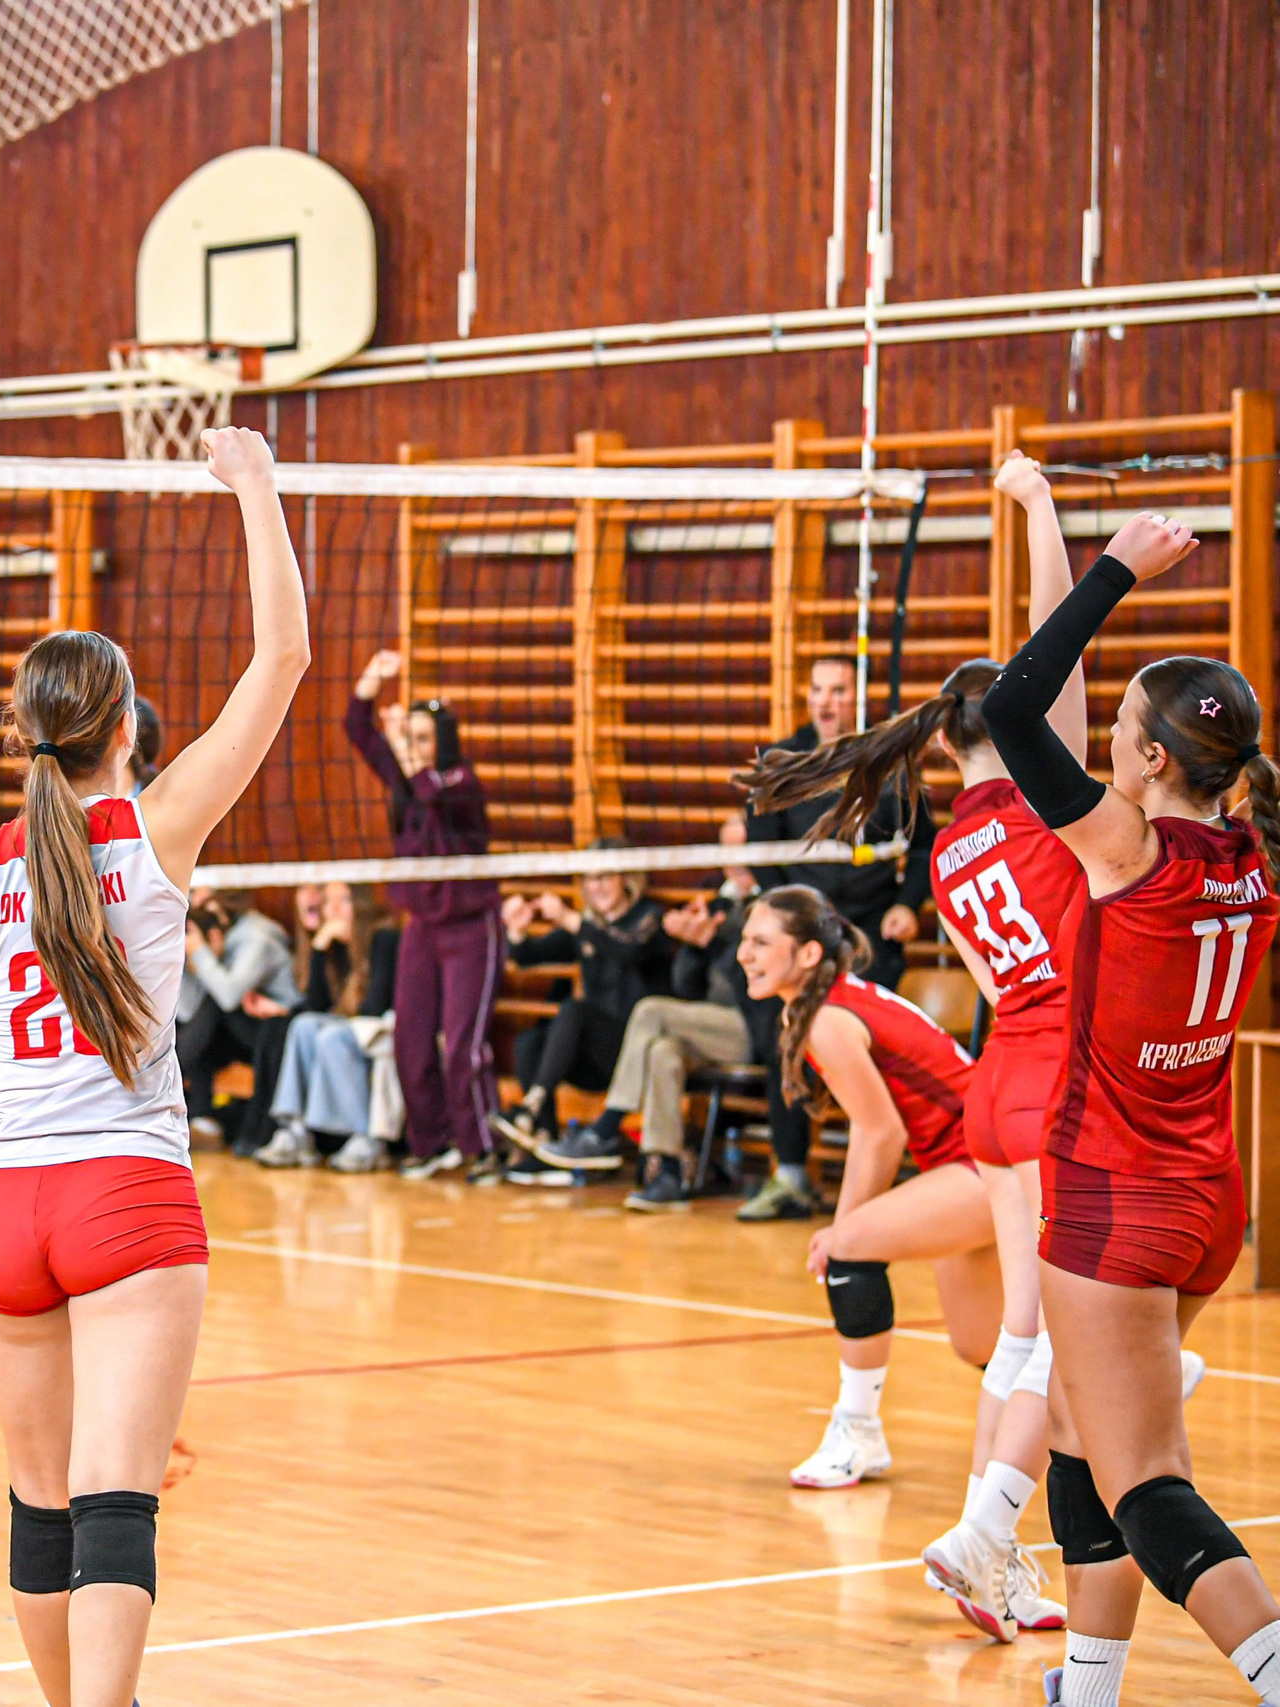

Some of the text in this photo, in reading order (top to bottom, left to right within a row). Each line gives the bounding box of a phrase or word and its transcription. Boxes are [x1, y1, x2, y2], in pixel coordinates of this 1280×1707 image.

[948, 859, 1051, 976] 33
[1185, 912, 1253, 1027] 11
[8, 936, 128, 1060] 2
